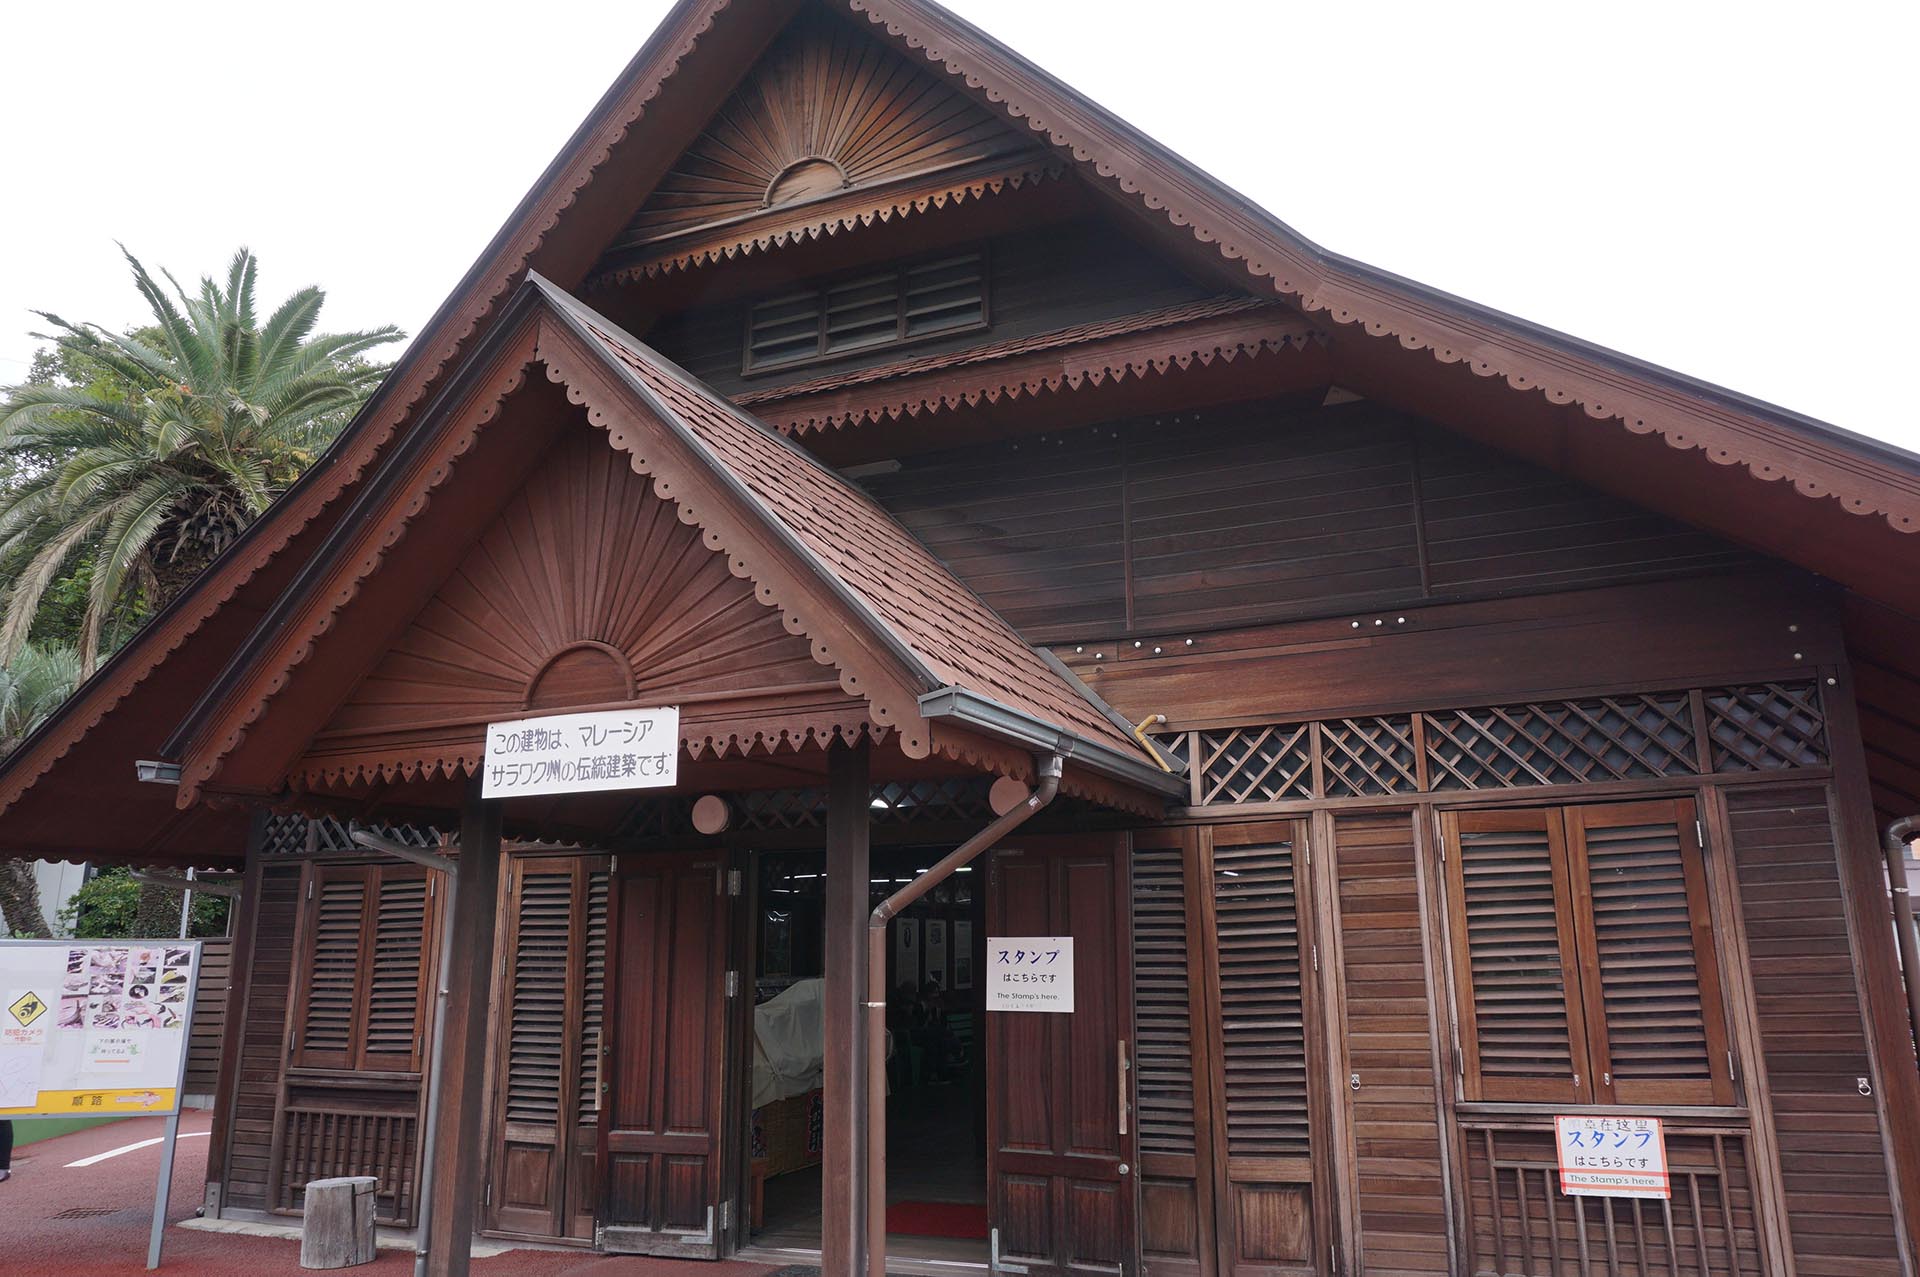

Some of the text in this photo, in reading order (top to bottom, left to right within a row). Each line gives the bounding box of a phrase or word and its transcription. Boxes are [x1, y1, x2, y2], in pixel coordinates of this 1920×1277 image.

[492, 751, 670, 787] サラワク州の伝統建築です。
[997, 949, 1060, 964] スタンプ
[1003, 973, 1056, 983] はこちらです
[998, 992, 1010, 1000] The
[1012, 992, 1040, 1001] Stamp's
[1568, 1130, 1653, 1148] スタンプ
[1575, 1156, 1648, 1168] はこちらです
[1570, 1175, 1587, 1183] The
[1591, 1175, 1628, 1185] Stamp's
